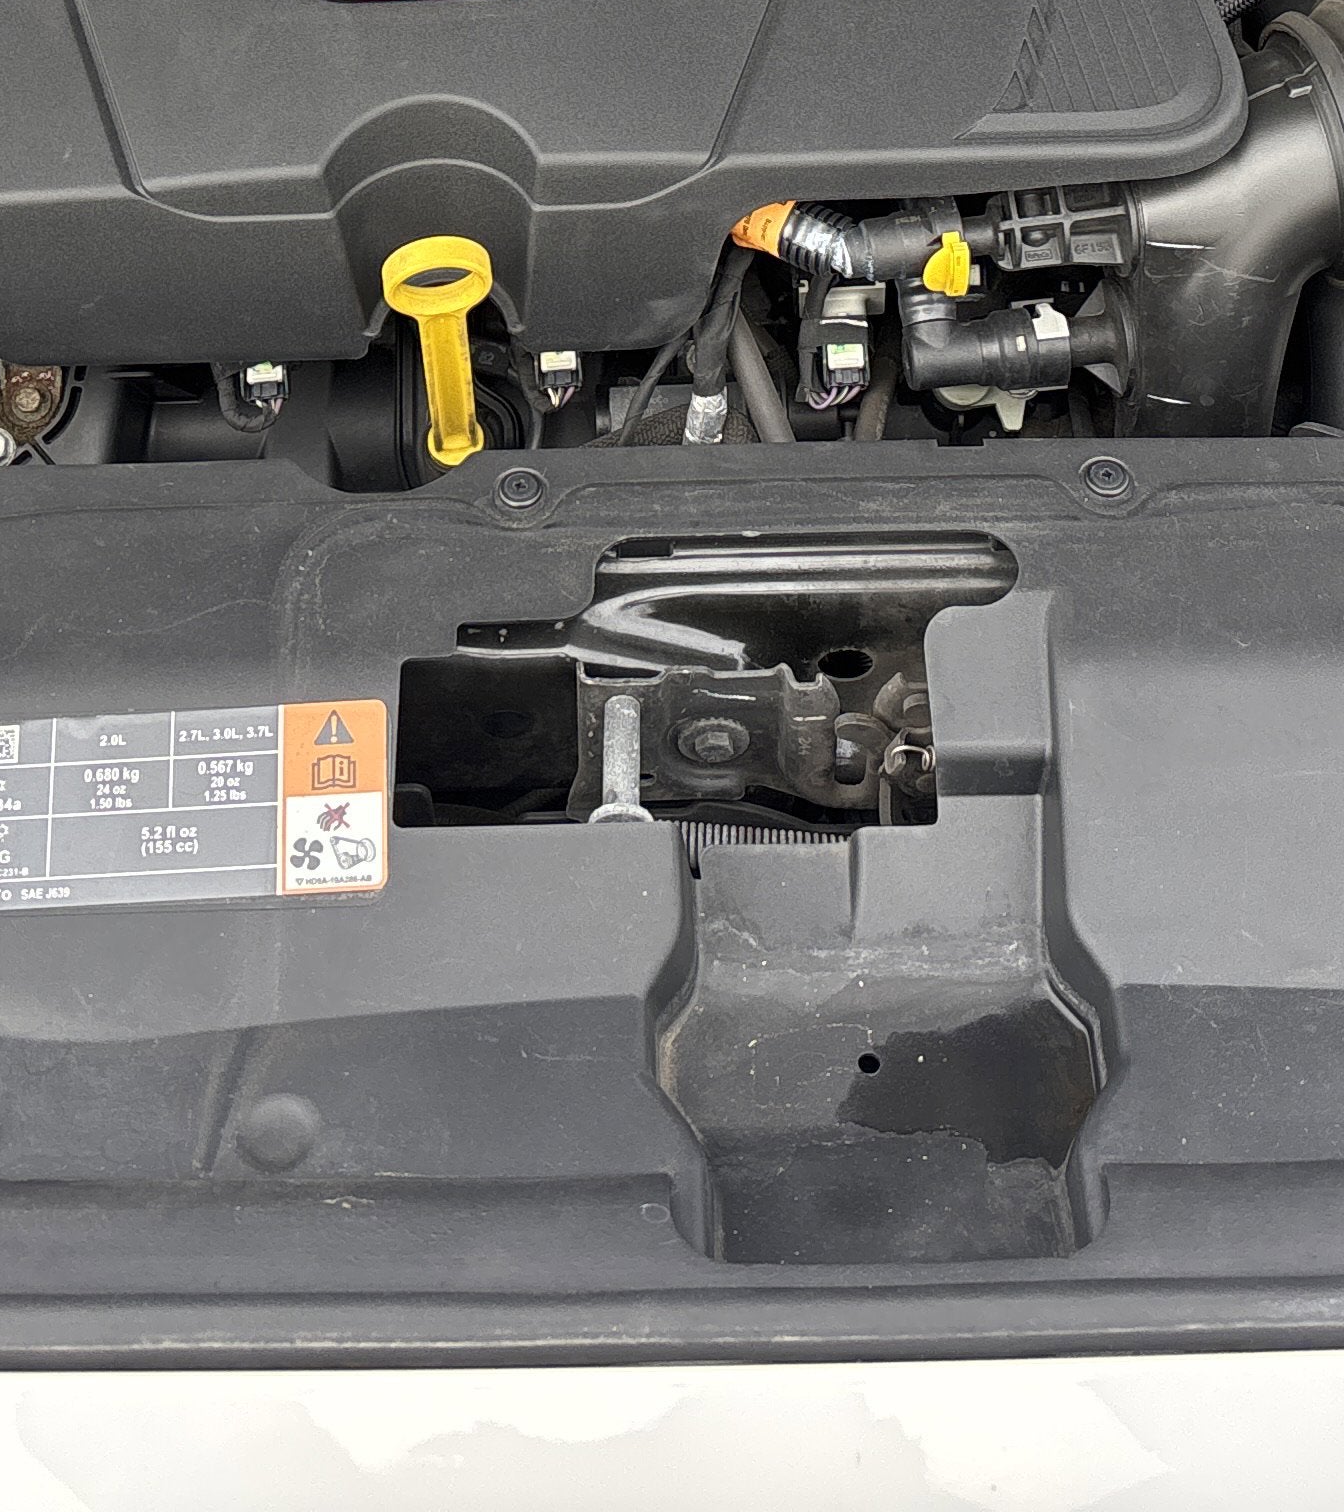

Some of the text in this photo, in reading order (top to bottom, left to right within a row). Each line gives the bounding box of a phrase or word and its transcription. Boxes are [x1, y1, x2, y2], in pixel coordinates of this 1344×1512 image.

[99, 734, 127, 747] 2.0L
[178, 725, 274, 742] 2.7L, 3.0L, 3.7L
[197, 759, 254, 776] 0.567 kg
[83, 767, 140, 784] 0.680 kg
[210, 776, 241, 788] 20 oz
[96, 784, 127, 796] 24 oz
[203, 789, 247, 802] 1.25 lbs
[89, 797, 133, 810] 1.50 lbs
[140, 825, 198, 840] 5.2 fl oz
[140, 839, 199, 857] (155 cc)
[20, 888, 44, 900] SAE
[45, 886, 71, 900] J639
